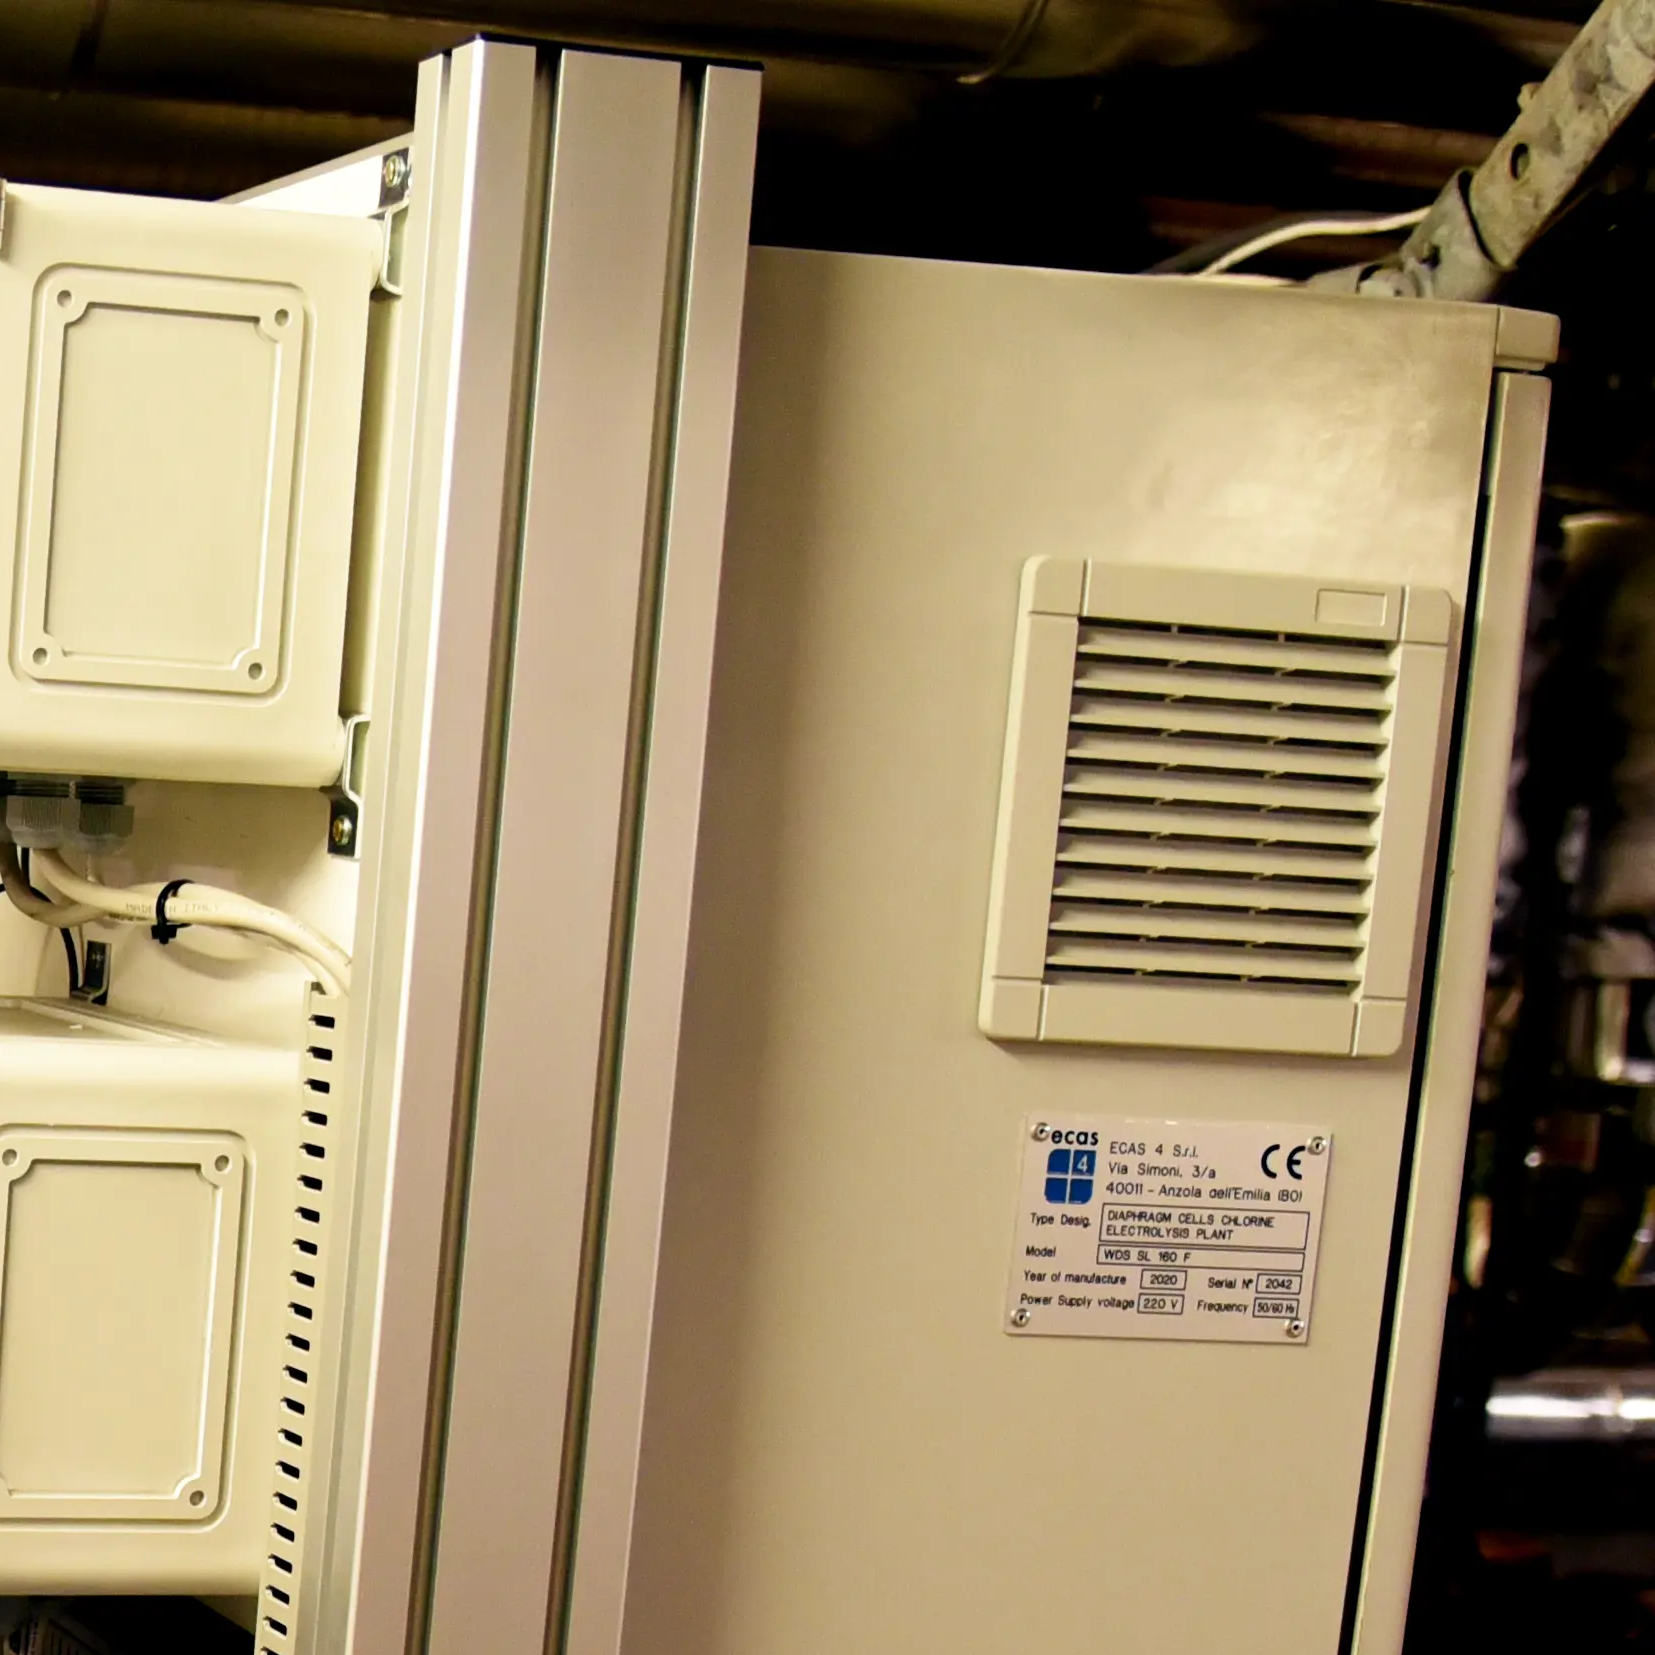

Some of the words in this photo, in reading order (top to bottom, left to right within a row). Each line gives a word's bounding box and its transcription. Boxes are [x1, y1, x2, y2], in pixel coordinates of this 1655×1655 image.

[1051, 1130, 1099, 1146] ecas
[1110, 1141, 1146, 1156] ECAS
[1155, 1143, 1163, 1156] 4
[1077, 1154, 1088, 1173] 4
[1260, 1143, 1306, 1180] CE
[1108, 1162, 1128, 1175] Via
[1192, 1165, 1216, 1179] 3/a
[1106, 1182, 1143, 1195] 40011
[1158, 1186, 1202, 1199] Anzola
[1030, 1212, 1055, 1226] Type
[1108, 1210, 1172, 1224] DIAPHRAGM
[1178, 1212, 1214, 1225] CELLS
[1221, 1215, 1275, 1228] CHLORINE
[1106, 1224, 1190, 1239] ELECTROLYSIS
[1196, 1228, 1233, 1240] PLANT
[1025, 1245, 1057, 1257] Model
[1104, 1248, 1131, 1261] WDS
[1137, 1250, 1151, 1261] SL
[1158, 1250, 1177, 1262] 160
[1183, 1252, 1191, 1263] F
[1024, 1270, 1047, 1282] Year
[1051, 1271, 1062, 1282] of
[1064, 1272, 1127, 1285] manufacture
[1149, 1273, 1178, 1285] 2020
[1208, 1276, 1237, 1289] Serial
[1265, 1278, 1293, 1290] 2042
[1020, 1293, 1053, 1305] Power
[1058, 1294, 1093, 1309] Supply
[1097, 1296, 1135, 1310] voltage
[1143, 1298, 1166, 1310] 220
[1170, 1299, 1179, 1310] V
[1197, 1299, 1250, 1314] Frequency
